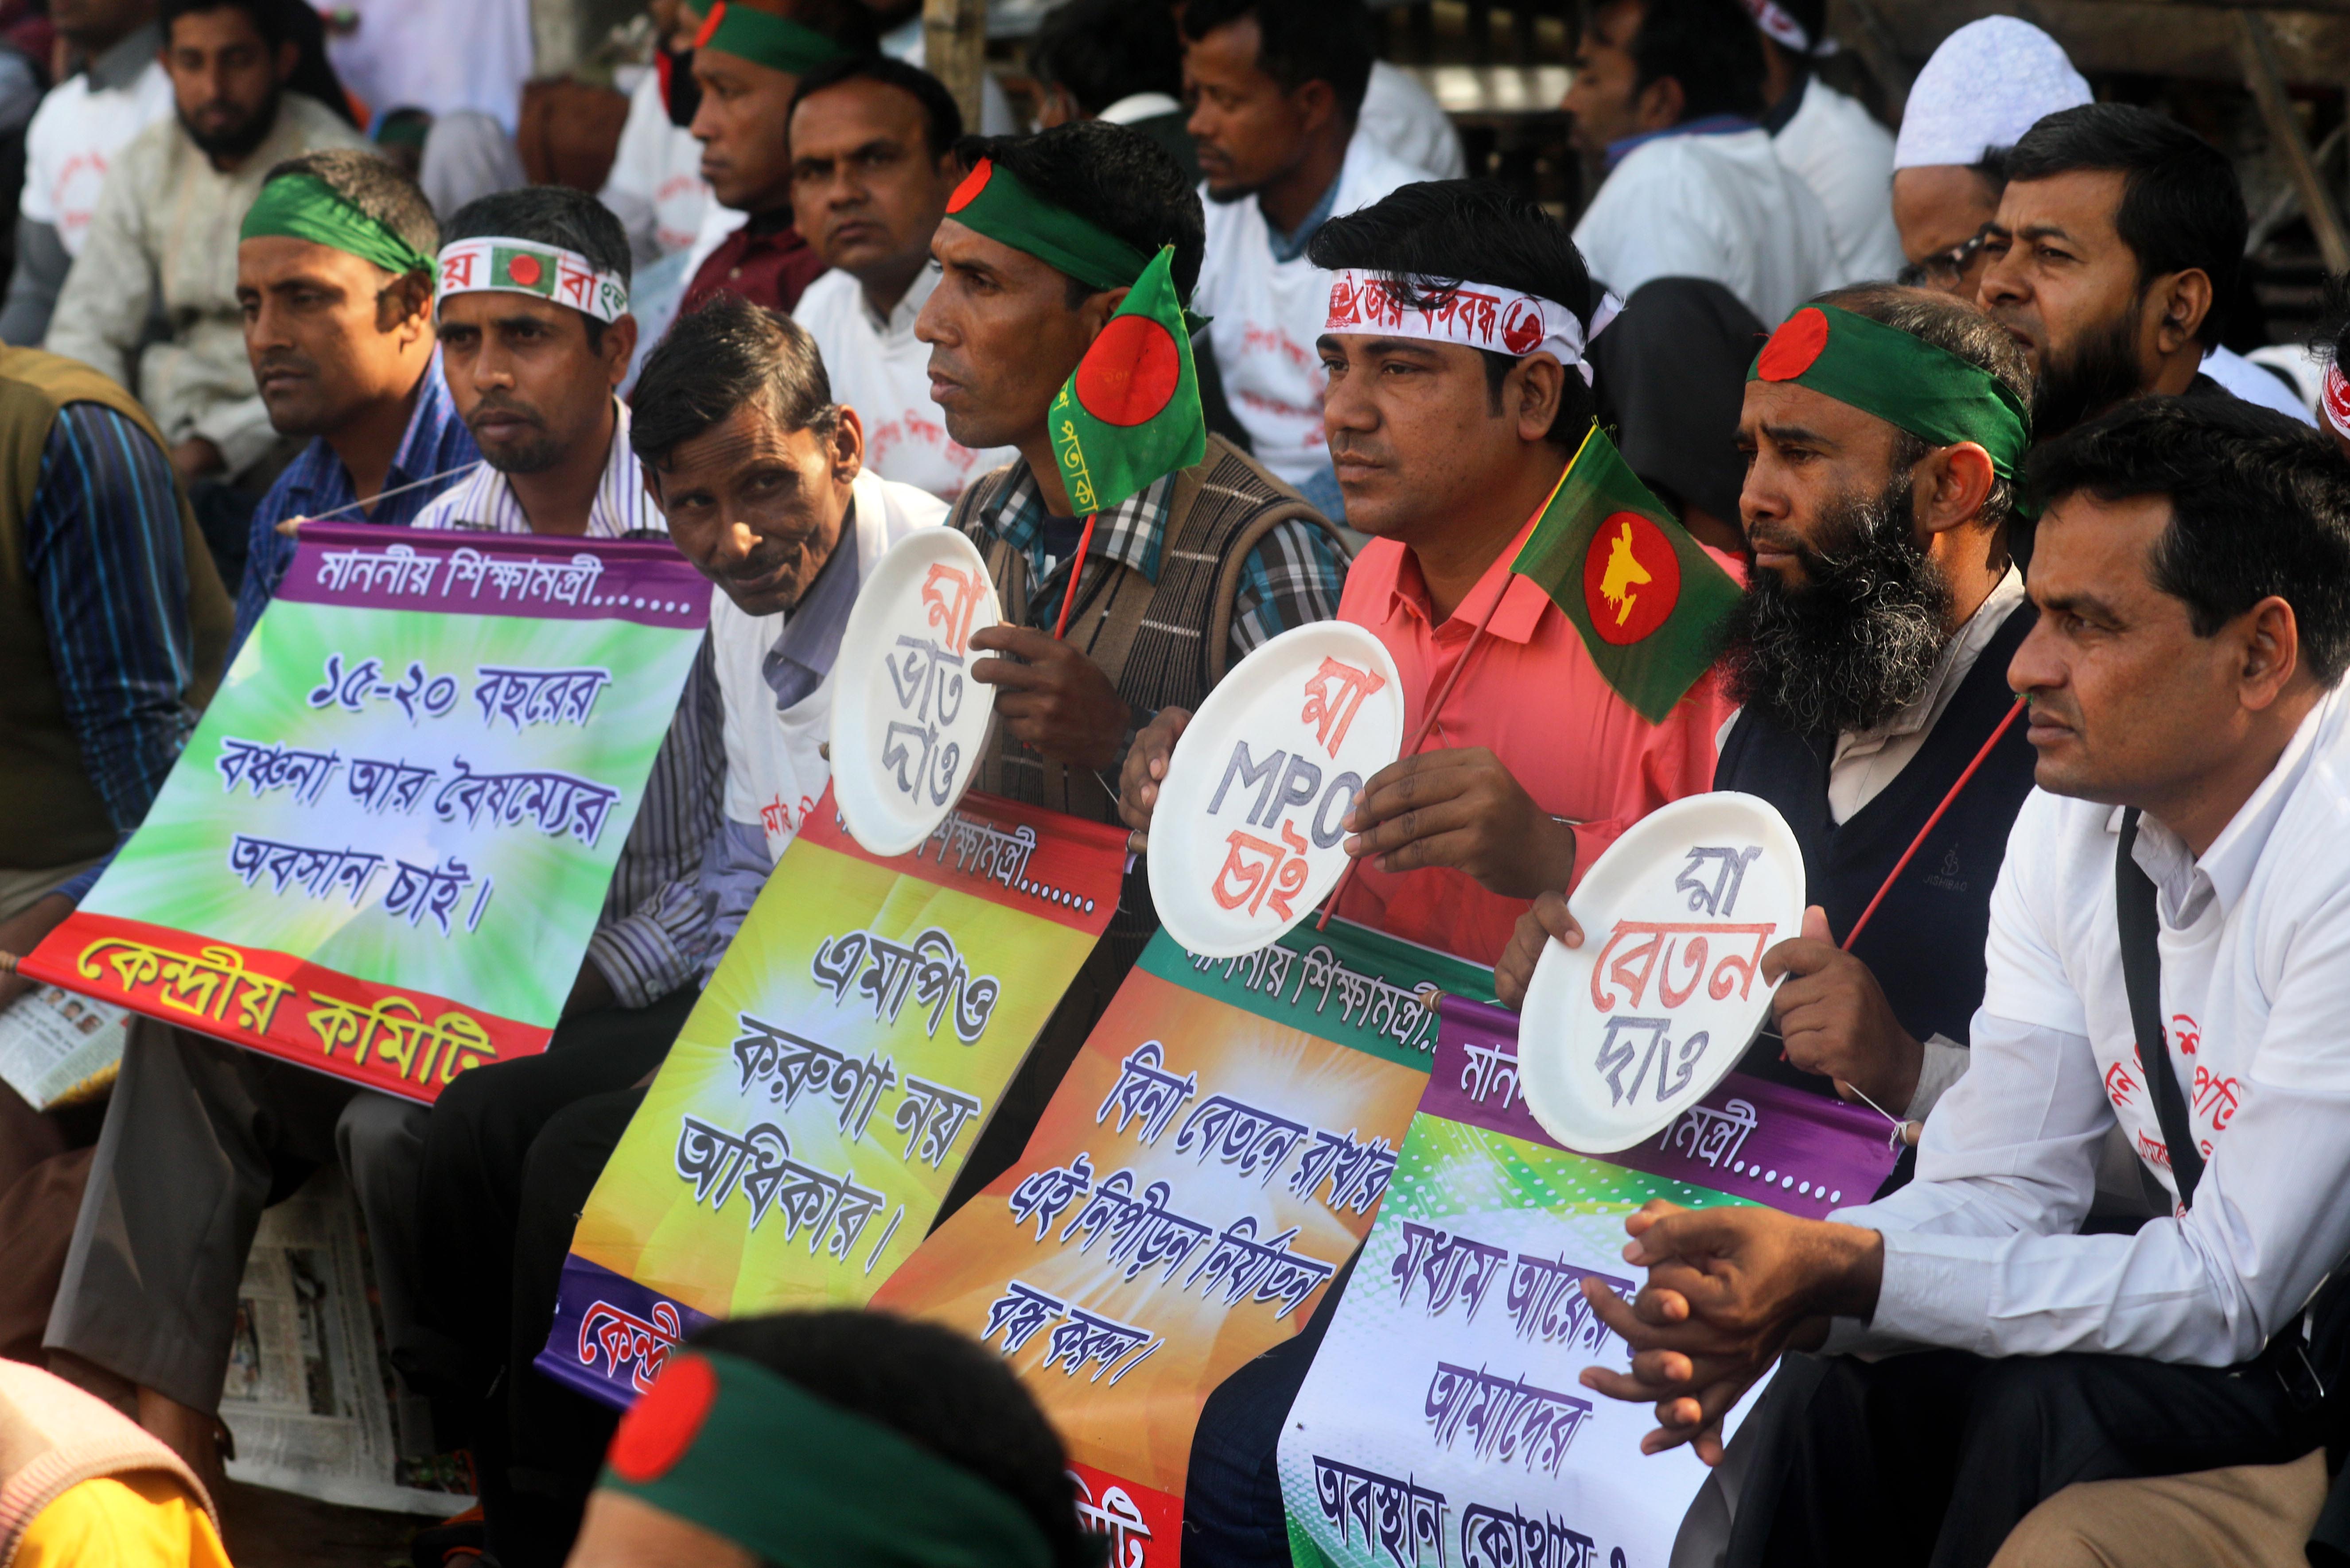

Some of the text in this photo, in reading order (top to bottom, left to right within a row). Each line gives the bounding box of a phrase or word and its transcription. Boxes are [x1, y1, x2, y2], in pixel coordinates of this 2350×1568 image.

[1058, 420, 1099, 512] পতাকা
[316, 543, 442, 597] মাননীয়
[922, 563, 987, 657] মা
[309, 655, 609, 729] ১৫-২০ বছরের
[885, 634, 965, 727] ভাত
[1301, 655, 1385, 760] মা
[219, 739, 619, 844] বঞ্চনা আর বৈষম্যের
[882, 721, 960, 807] দাও
[1206, 739, 1365, 850] MPO
[232, 835, 386, 904] অবসান
[1211, 819, 1309, 923] চাই
[1675, 845, 1763, 917] মা
[77, 937, 296, 1036] কেন্দ্রীয়
[307, 995, 498, 1084] কমিটি
[812, 927, 1000, 1041] এমপিও
[1590, 918, 1777, 1013] বেতন
[732, 1013, 982, 1168] করুণা নয়
[1594, 1014, 1709, 1108] দাও
[1097, 1041, 1398, 1215] বিনা বেতনে রাখার
[1009, 1152, 1337, 1320] এই নিপীড়ন নির্যাতন
[1392, 1220, 1508, 1320] মধ্যম
[980, 1279, 1067, 1352] বন্ধ
[1423, 1362, 1593, 1473] আমাদের
[1312, 1455, 1448, 1568] অবস্থান
